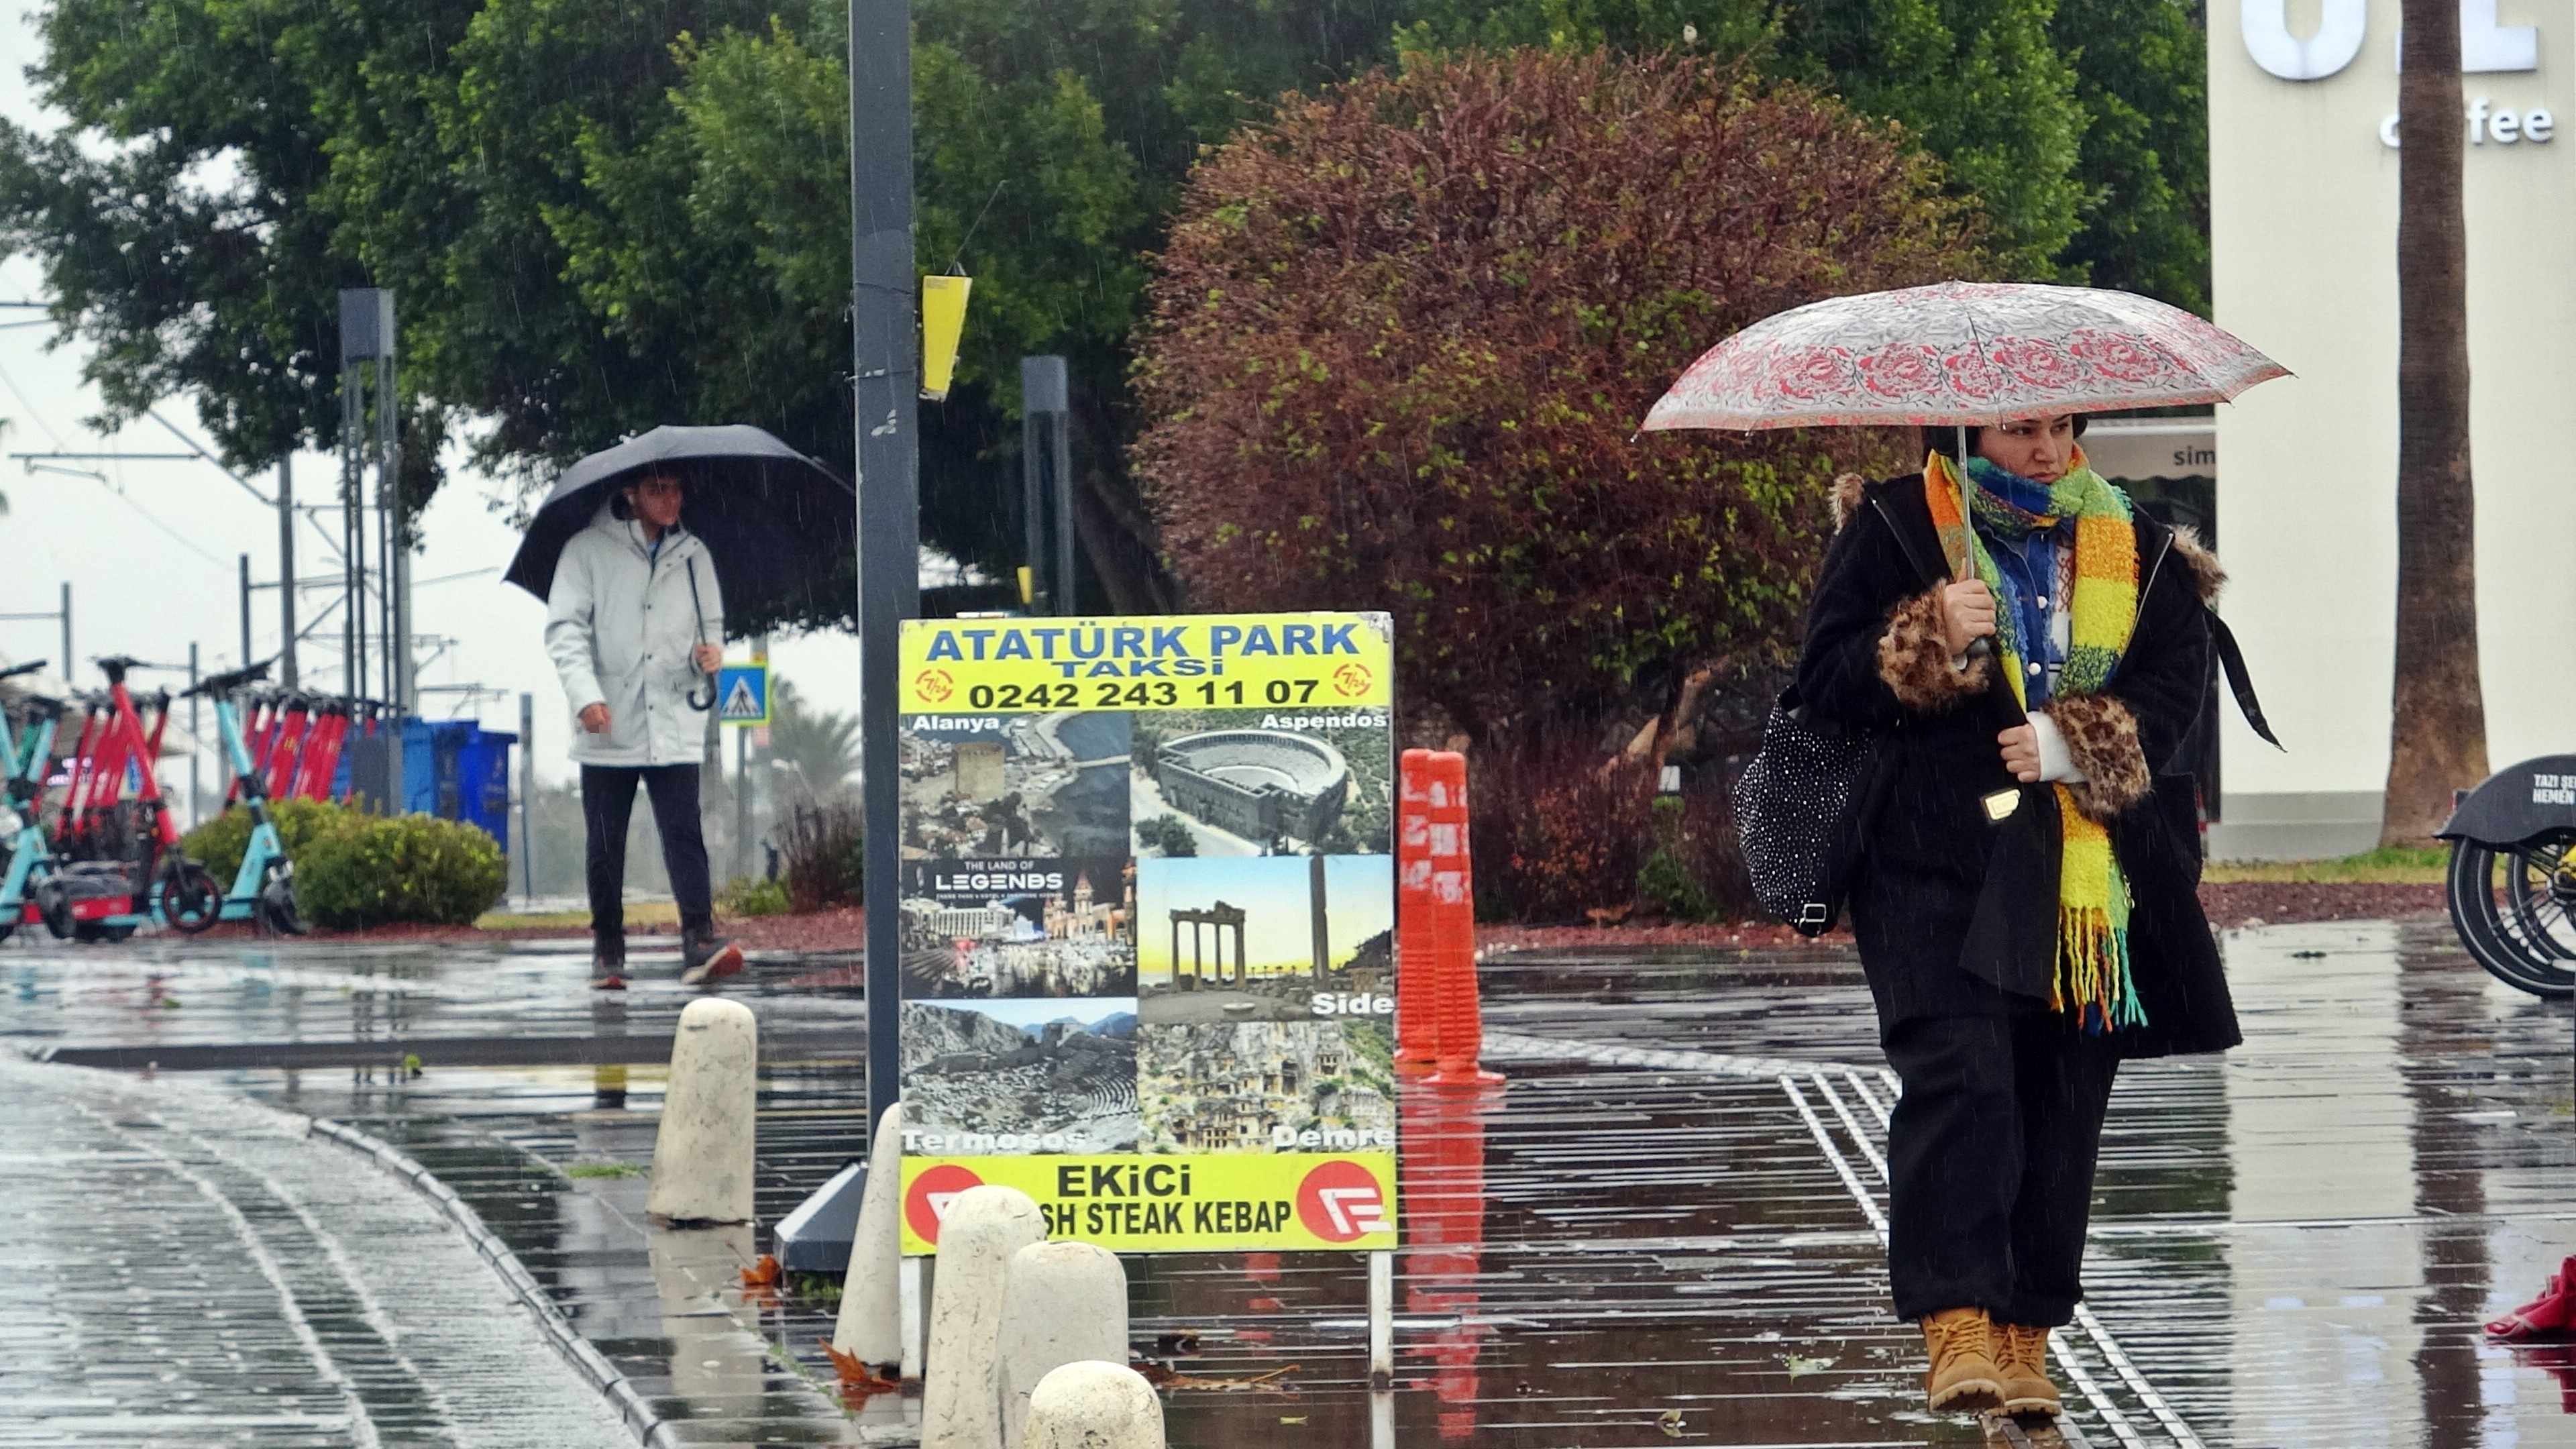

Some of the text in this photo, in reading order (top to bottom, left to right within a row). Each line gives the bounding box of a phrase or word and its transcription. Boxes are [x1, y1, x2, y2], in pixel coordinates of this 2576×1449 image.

[2379, 97, 2553, 148] cfee
[926, 621, 1360, 661] ATATÜRK PARK
[969, 680, 1319, 708] 0242 243 11 07
[912, 715, 1000, 733] Alanya
[1260, 712, 1387, 731] Aspendos
[2532, 788, 2575, 805] HEMEN
[964, 861, 1034, 871] THE LAND OF
[1311, 992, 1393, 1014] Side
[901, 1128, 1086, 1151] Termosos
[1273, 1125, 1396, 1148] Demre
[1087, 1202, 1184, 1234] STEAK
[1195, 1201, 1291, 1233] KEBAP
